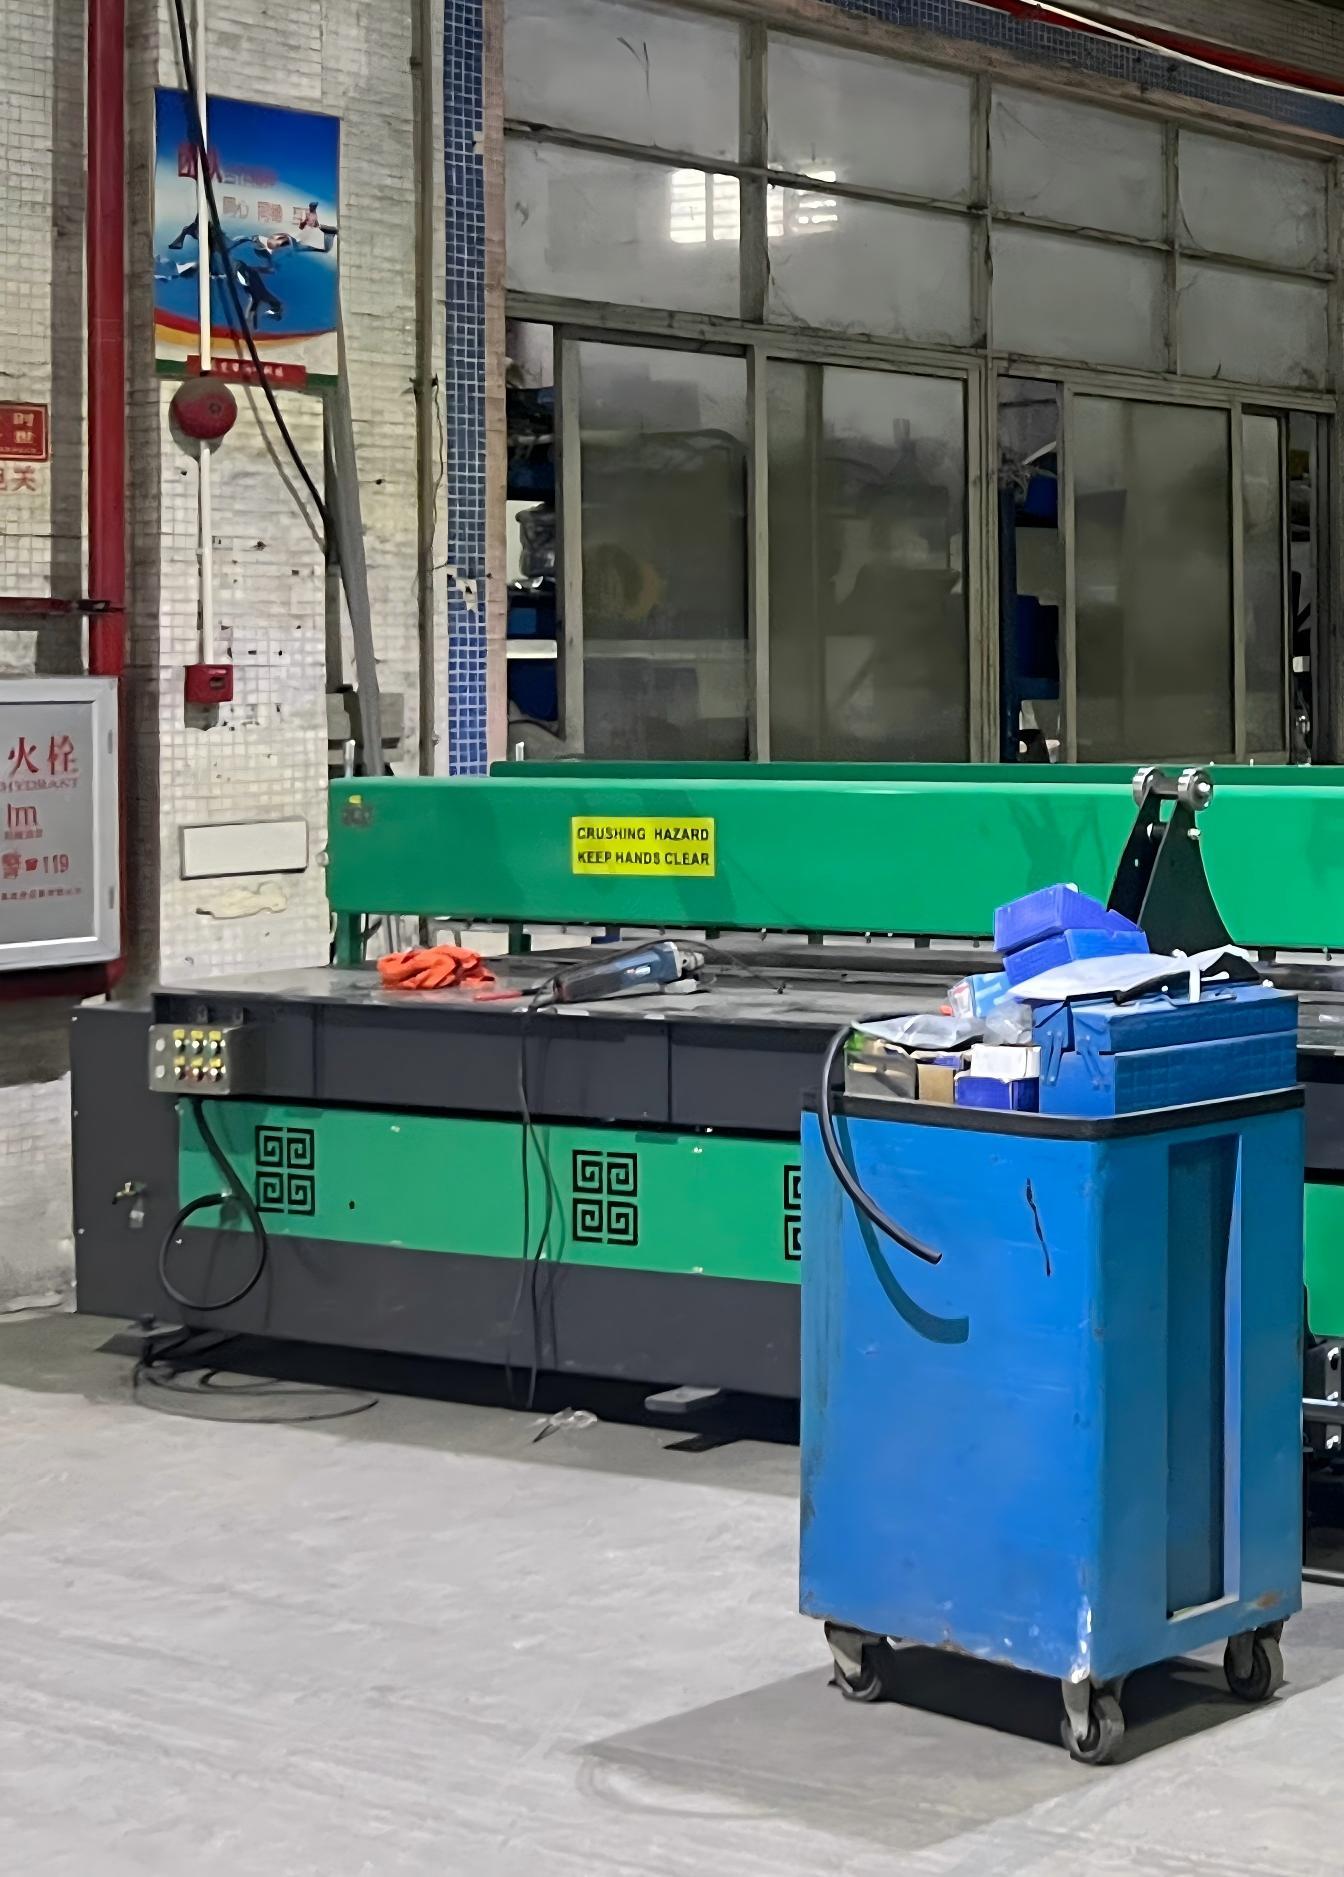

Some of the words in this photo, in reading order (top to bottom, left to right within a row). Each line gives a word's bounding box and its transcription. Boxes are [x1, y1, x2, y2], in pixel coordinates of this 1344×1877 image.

[7, 734, 80, 778] 火栓
[577, 826, 646, 840] CRUSHING
[654, 828, 709, 841] HAZARD
[577, 851, 612, 864] KEEP
[615, 852, 660, 865] HANDS
[664, 852, 710, 866] CLEAR
